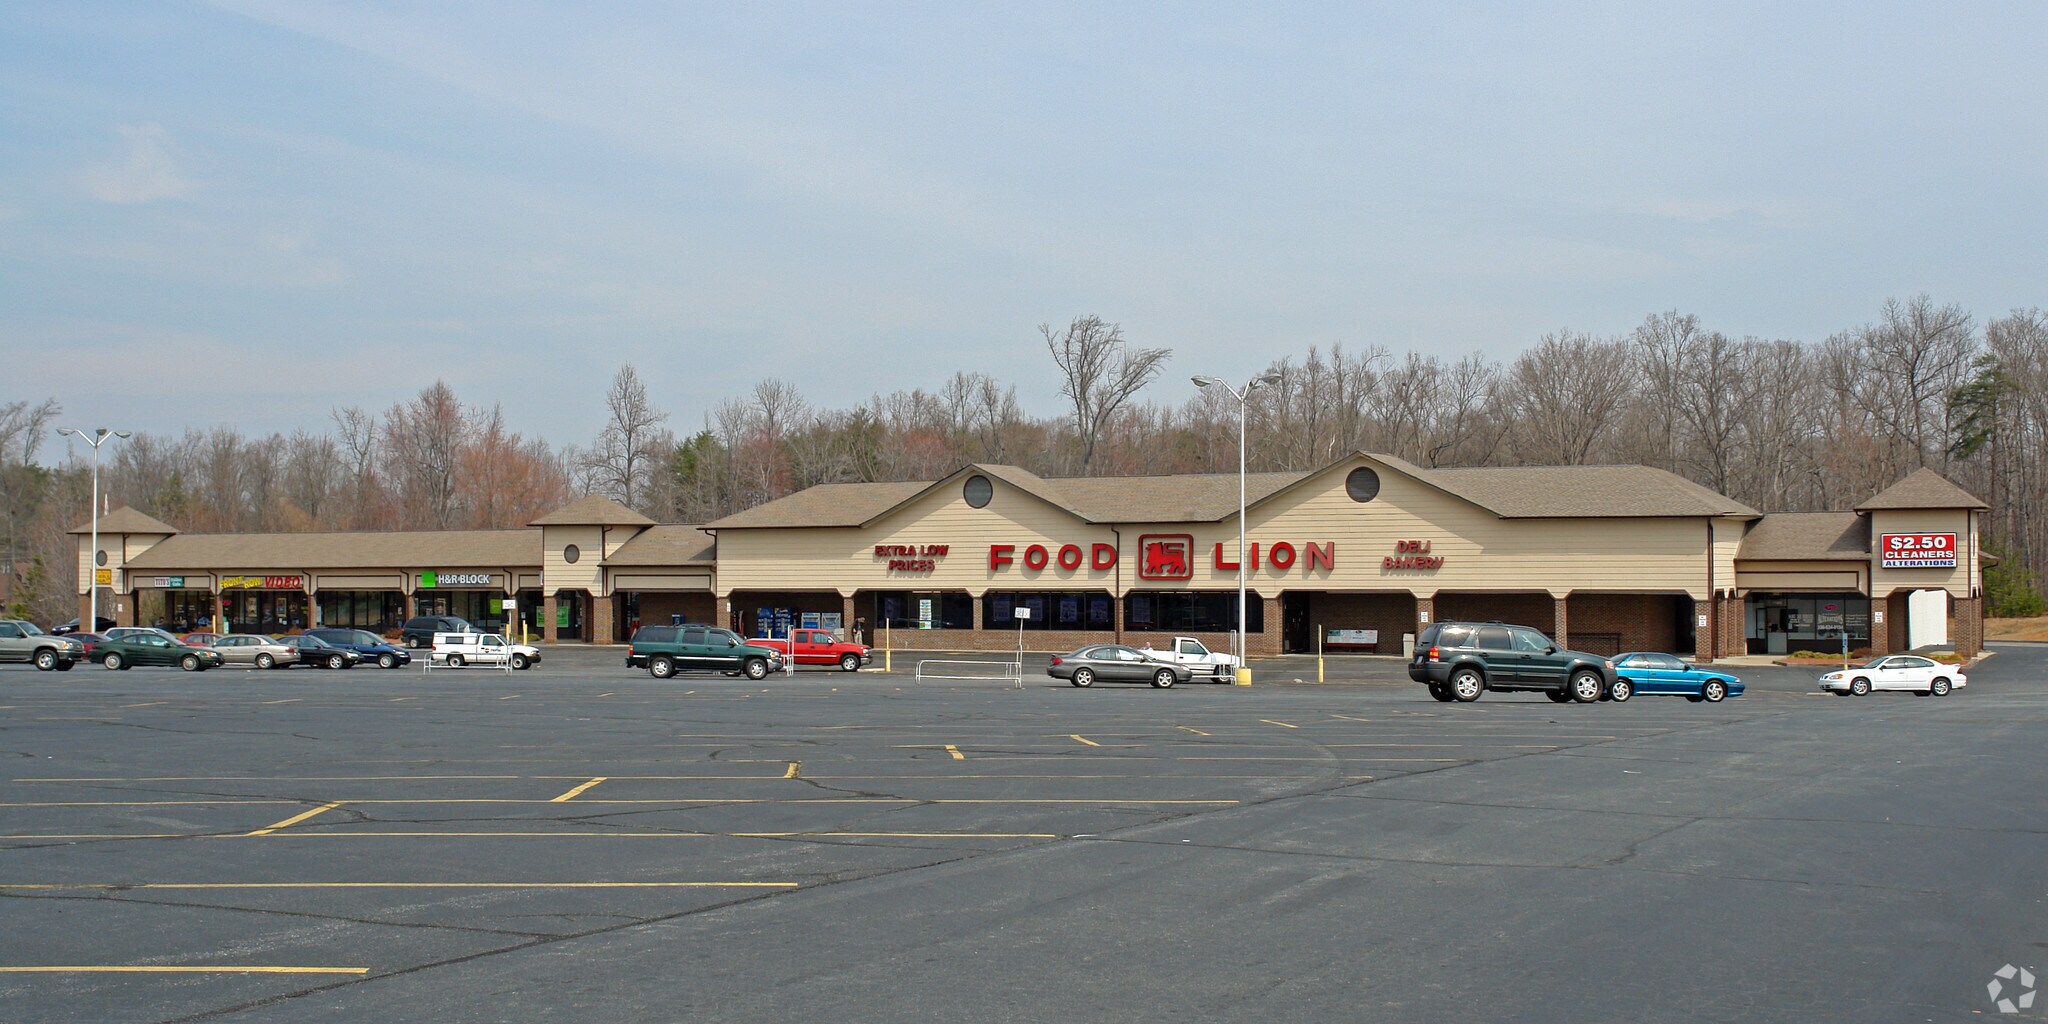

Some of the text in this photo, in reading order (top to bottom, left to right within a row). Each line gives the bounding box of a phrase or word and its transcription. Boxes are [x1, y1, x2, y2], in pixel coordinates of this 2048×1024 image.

[1397, 540, 1431, 553] DELI
[1890, 536, 1947, 550] $2.50
[874, 544, 950, 556] EXTRA LOW
[990, 541, 1335, 571] FOOD LION
[1885, 550, 1954, 558] CLEANERS
[888, 559, 936, 571] PRICES
[1383, 556, 1445, 569] BAKERY
[220, 575, 302, 589] FRONT ROW VIDEO
[438, 574, 490, 584] H&R BLOCK
